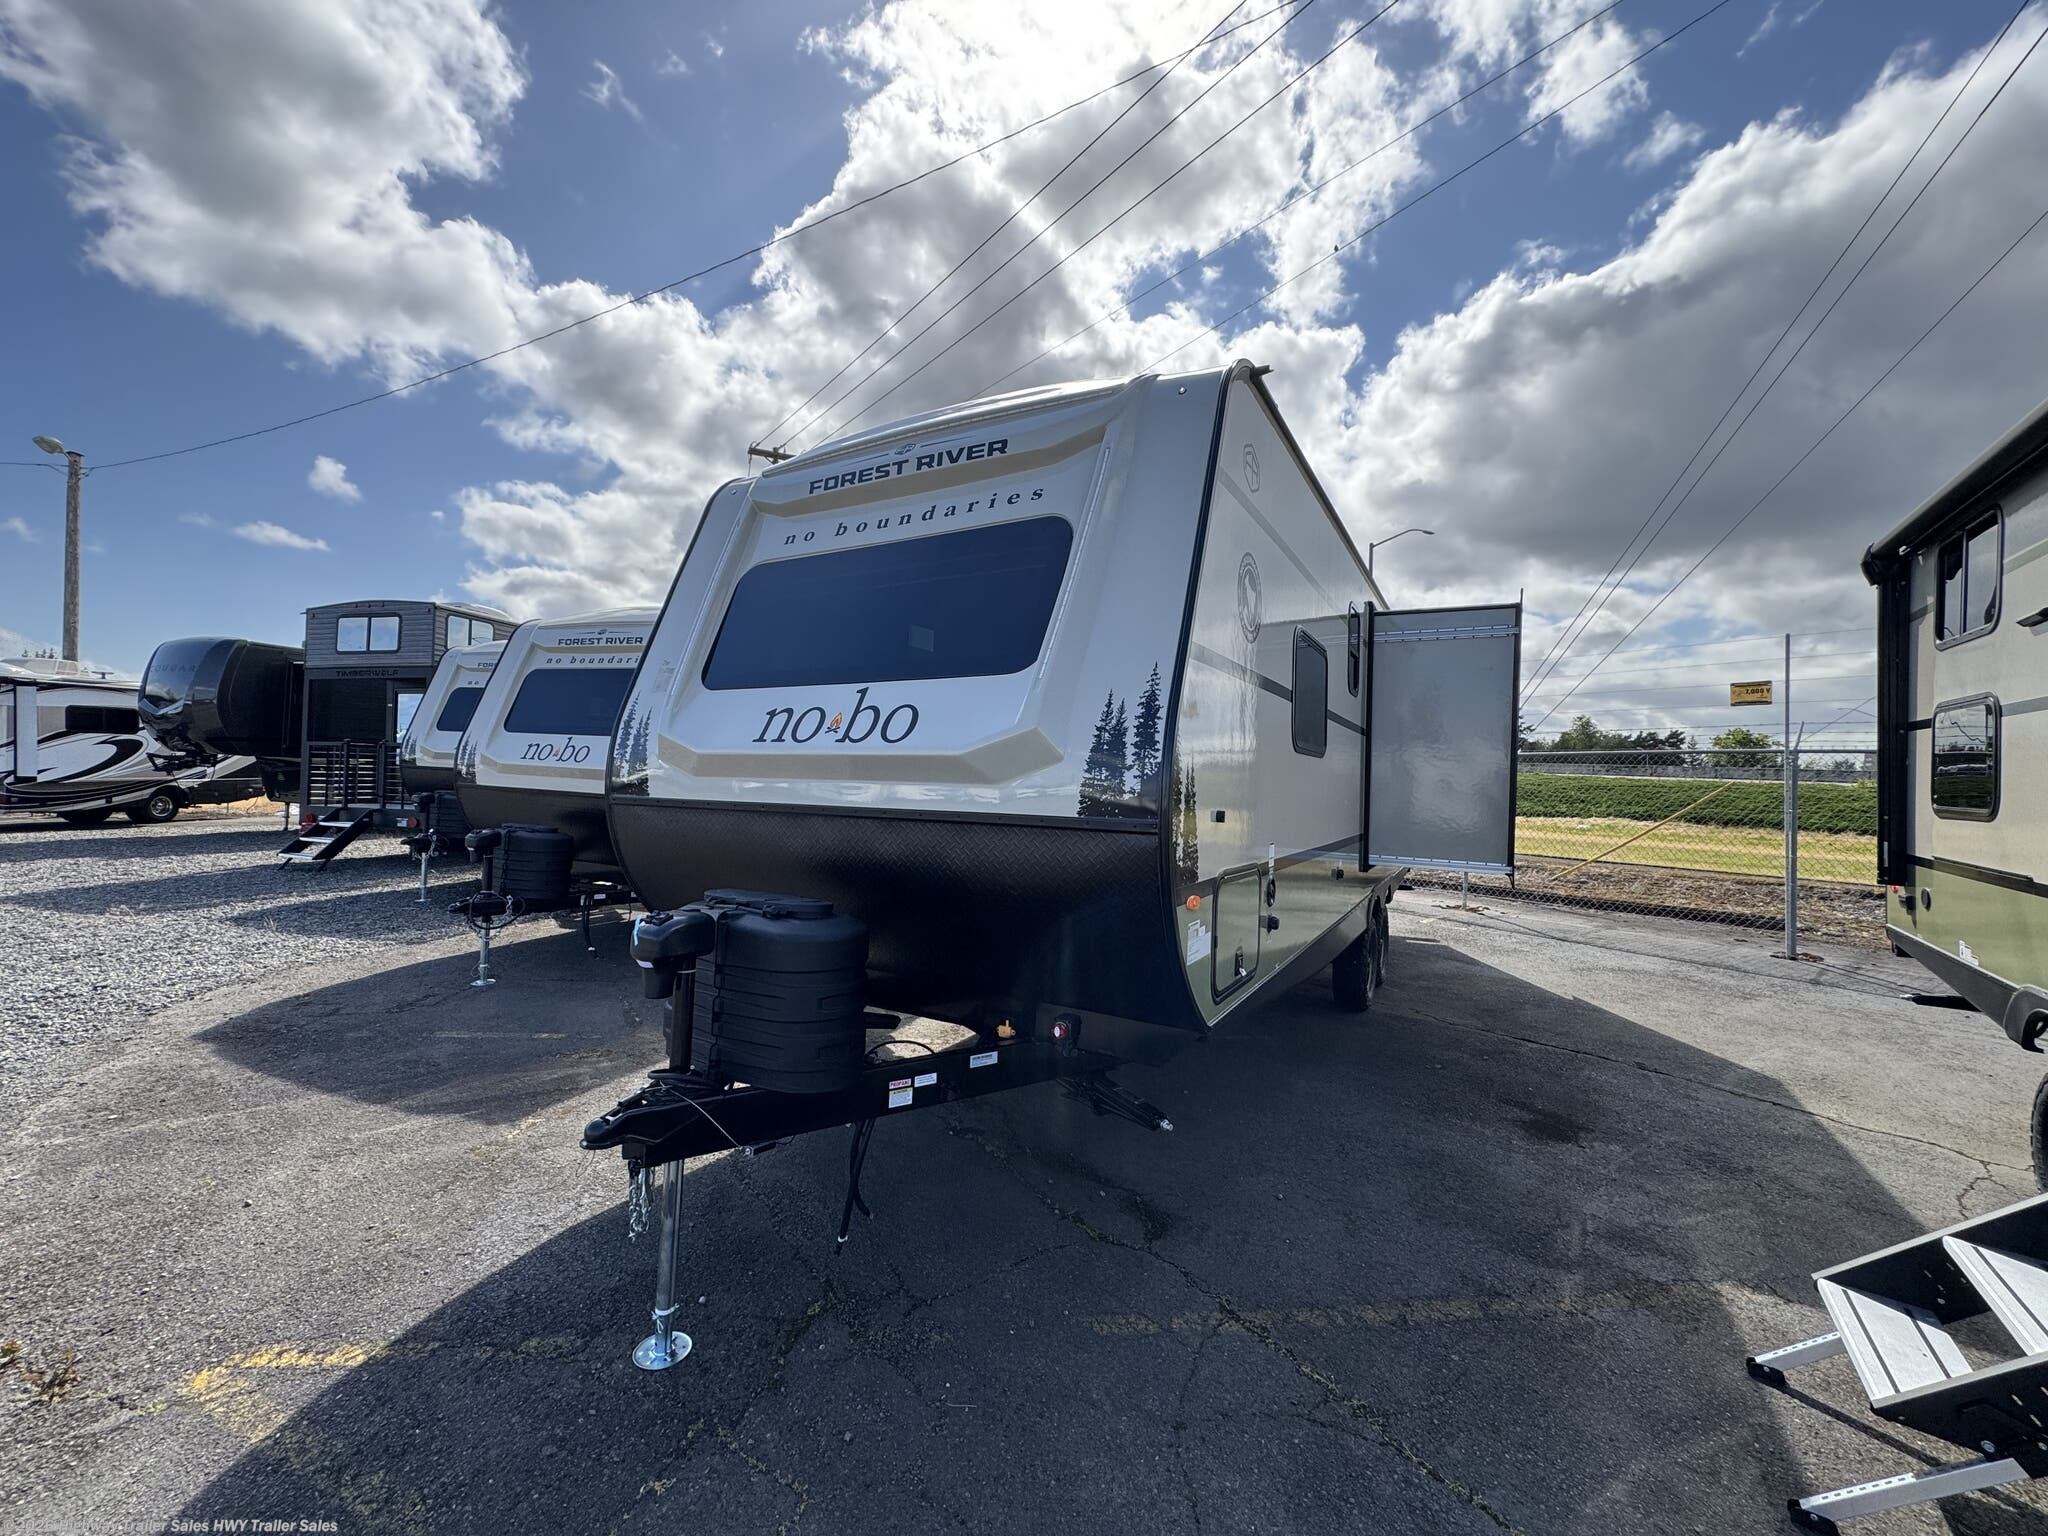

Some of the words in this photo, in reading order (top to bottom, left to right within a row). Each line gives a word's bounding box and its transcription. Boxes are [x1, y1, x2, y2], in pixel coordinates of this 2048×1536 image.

[808, 459, 909, 495] FOREST
[916, 438, 1008, 472] RIVER
[784, 530, 815, 546] no
[834, 487, 1044, 537] boundaries
[558, 637, 603, 646] FOREST
[605, 636, 644, 645] RIVER
[570, 655, 640, 664] boundari
